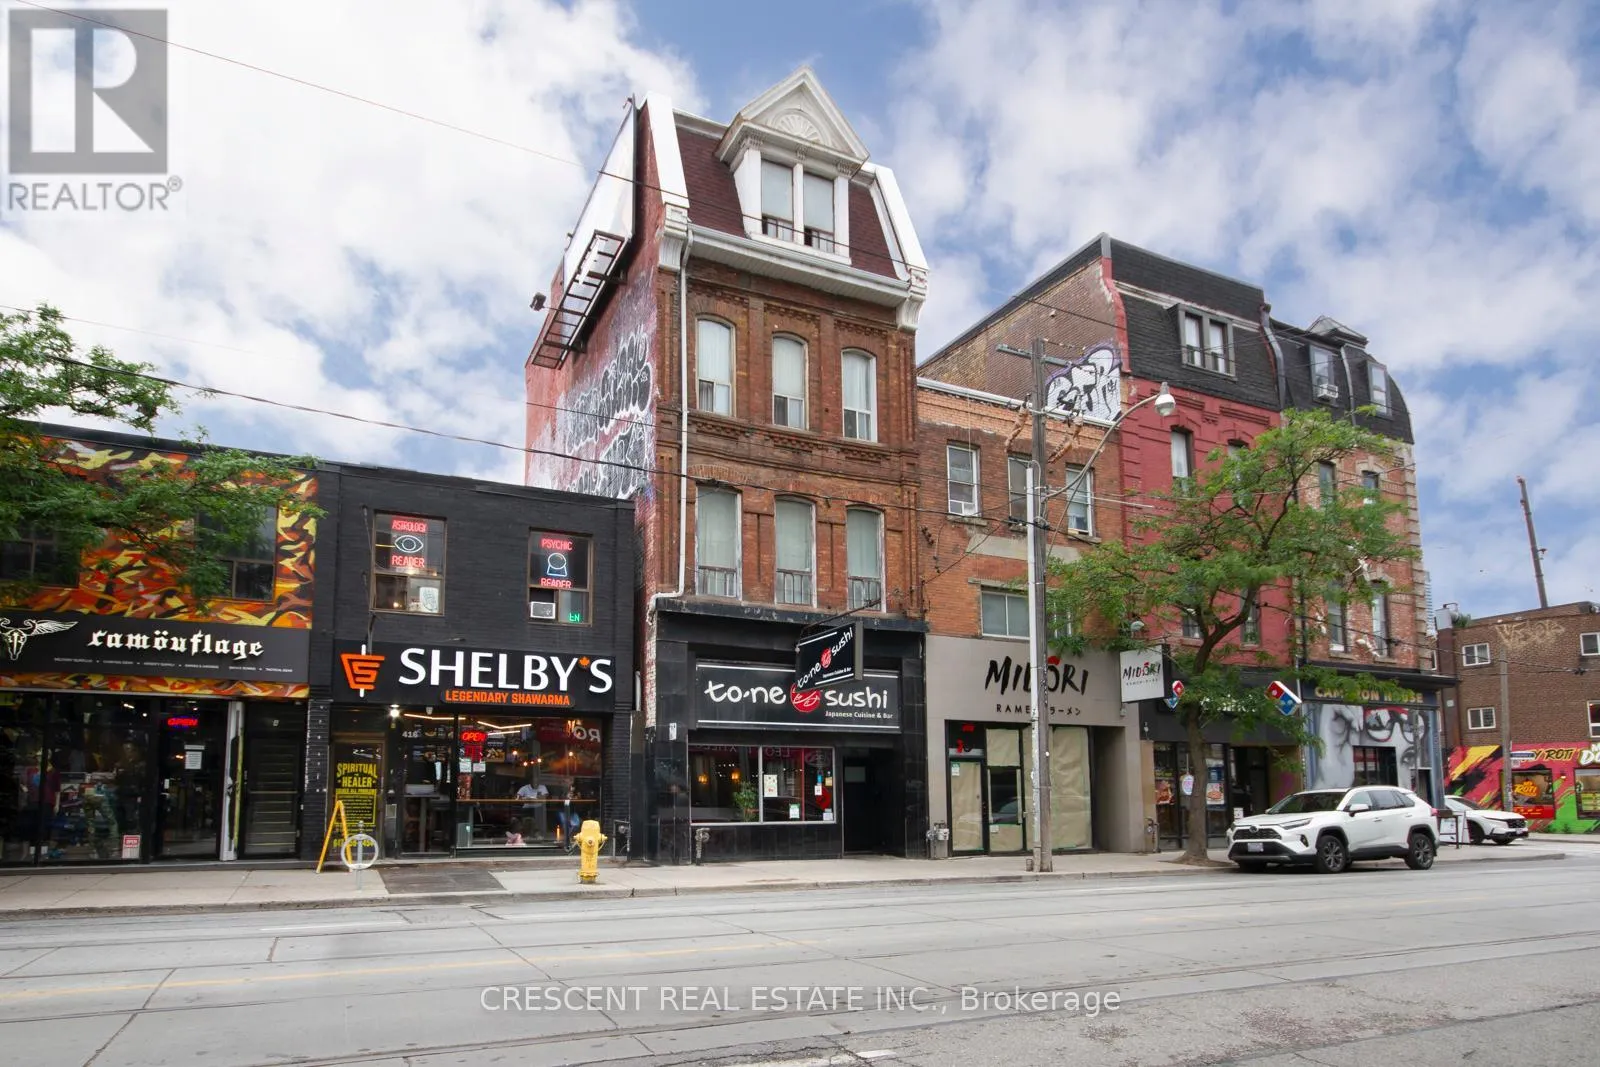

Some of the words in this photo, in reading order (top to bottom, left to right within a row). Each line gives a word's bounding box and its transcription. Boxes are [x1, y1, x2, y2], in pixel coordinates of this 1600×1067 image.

[391, 519, 427, 533] ASTROLOGY
[541, 538, 573, 551] PSYCHIC
[391, 555, 425, 567] READER
[541, 577, 572, 589] READER
[831, 626, 853, 656] sushi
[398, 647, 613, 693] SHELBY'S
[445, 690, 508, 704] LEGENDARY
[511, 693, 570, 706] SHAWARMA
[824, 687, 888, 709] sushi
[825, 711, 853, 719] Japanese
[854, 711, 876, 719] Cuisine
[996, 704, 1031, 715] RAME
[462, 731, 486, 742] OPEN
[1545, 748, 1576, 761] ROTI
[336, 763, 378, 779] SPIRITUAL
[342, 776, 373, 788] HEALER
